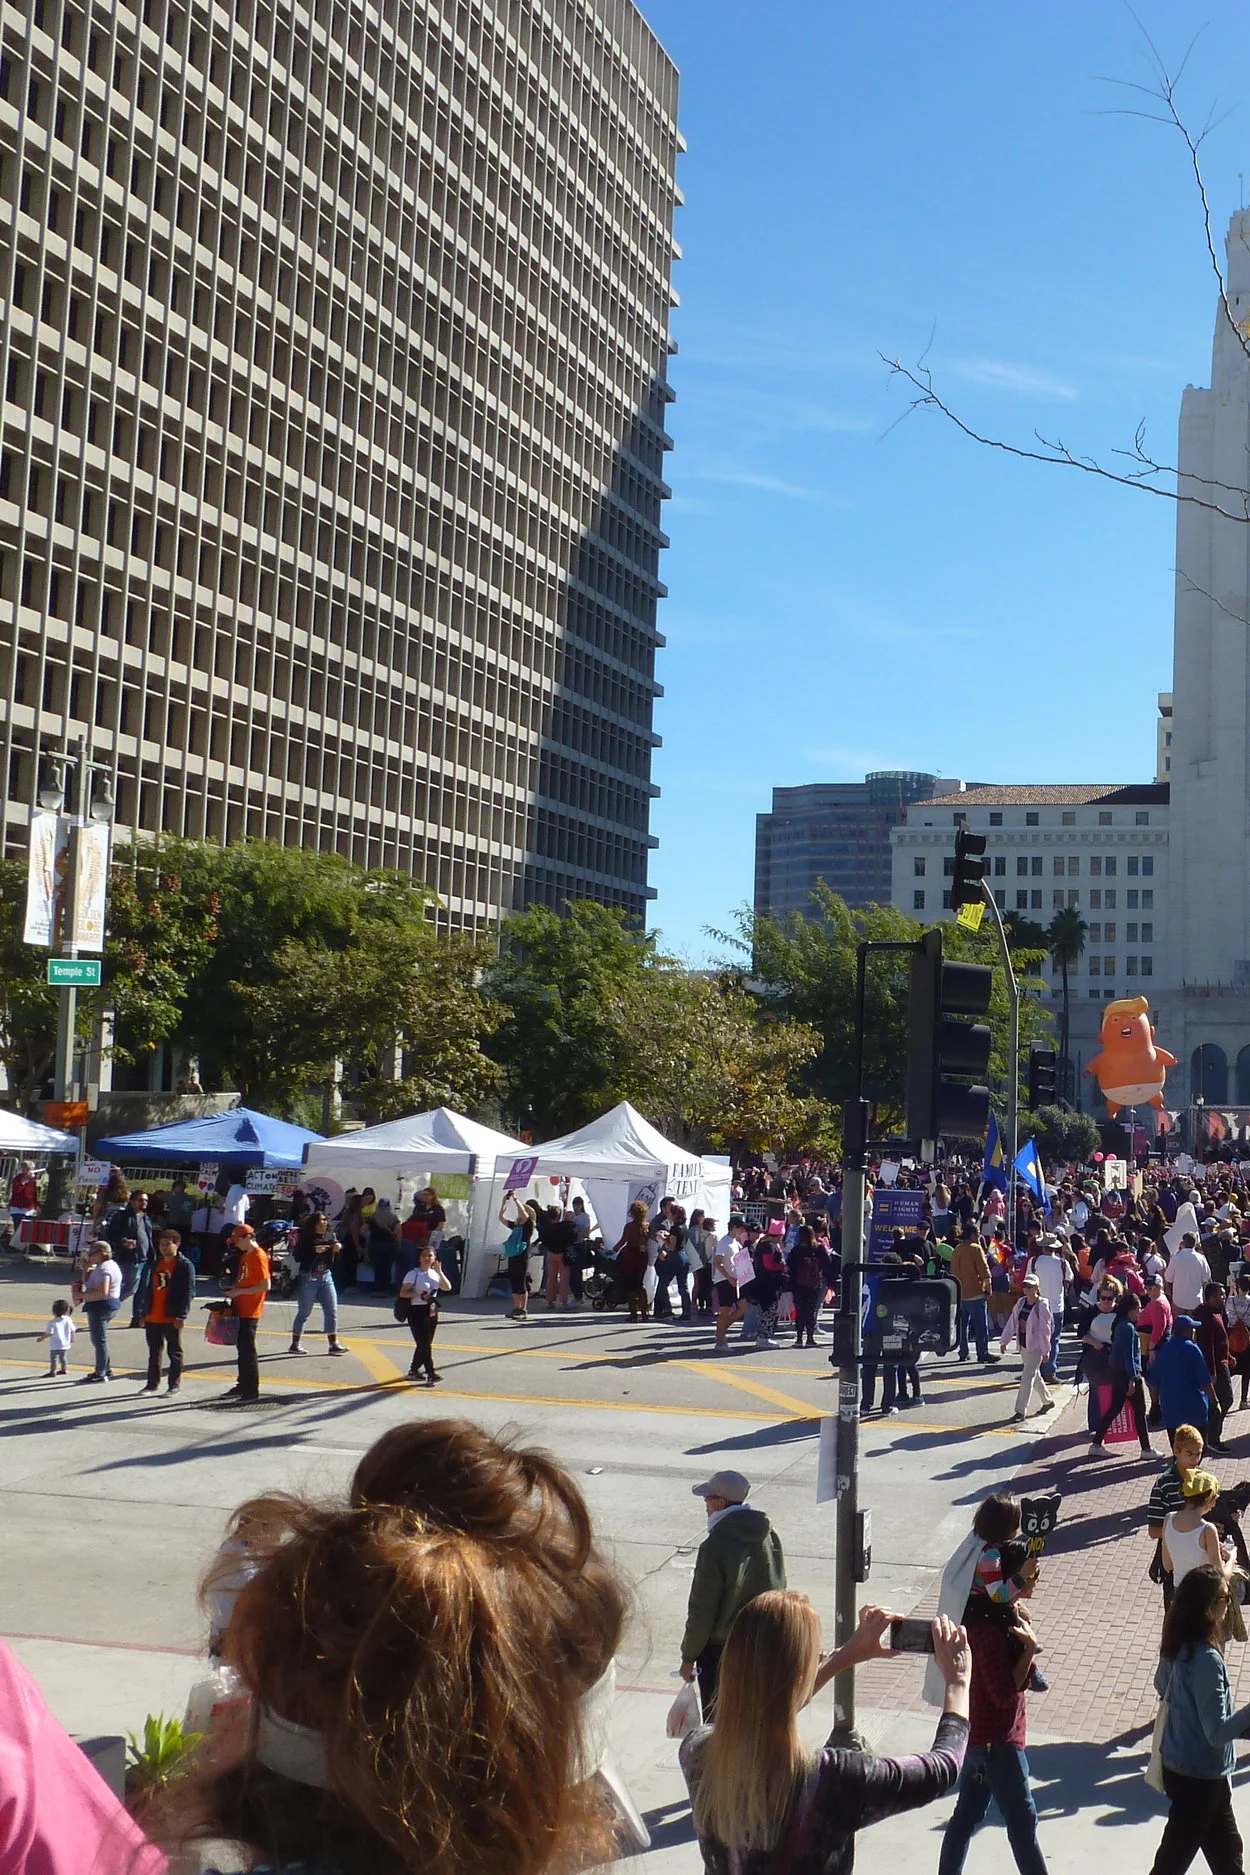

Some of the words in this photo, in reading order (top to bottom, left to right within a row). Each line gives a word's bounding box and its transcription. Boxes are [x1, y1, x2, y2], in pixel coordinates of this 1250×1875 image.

[53, 966, 83, 978] Temple
[86, 966, 96, 977] St
[248, 1171, 265, 1181] ACT
